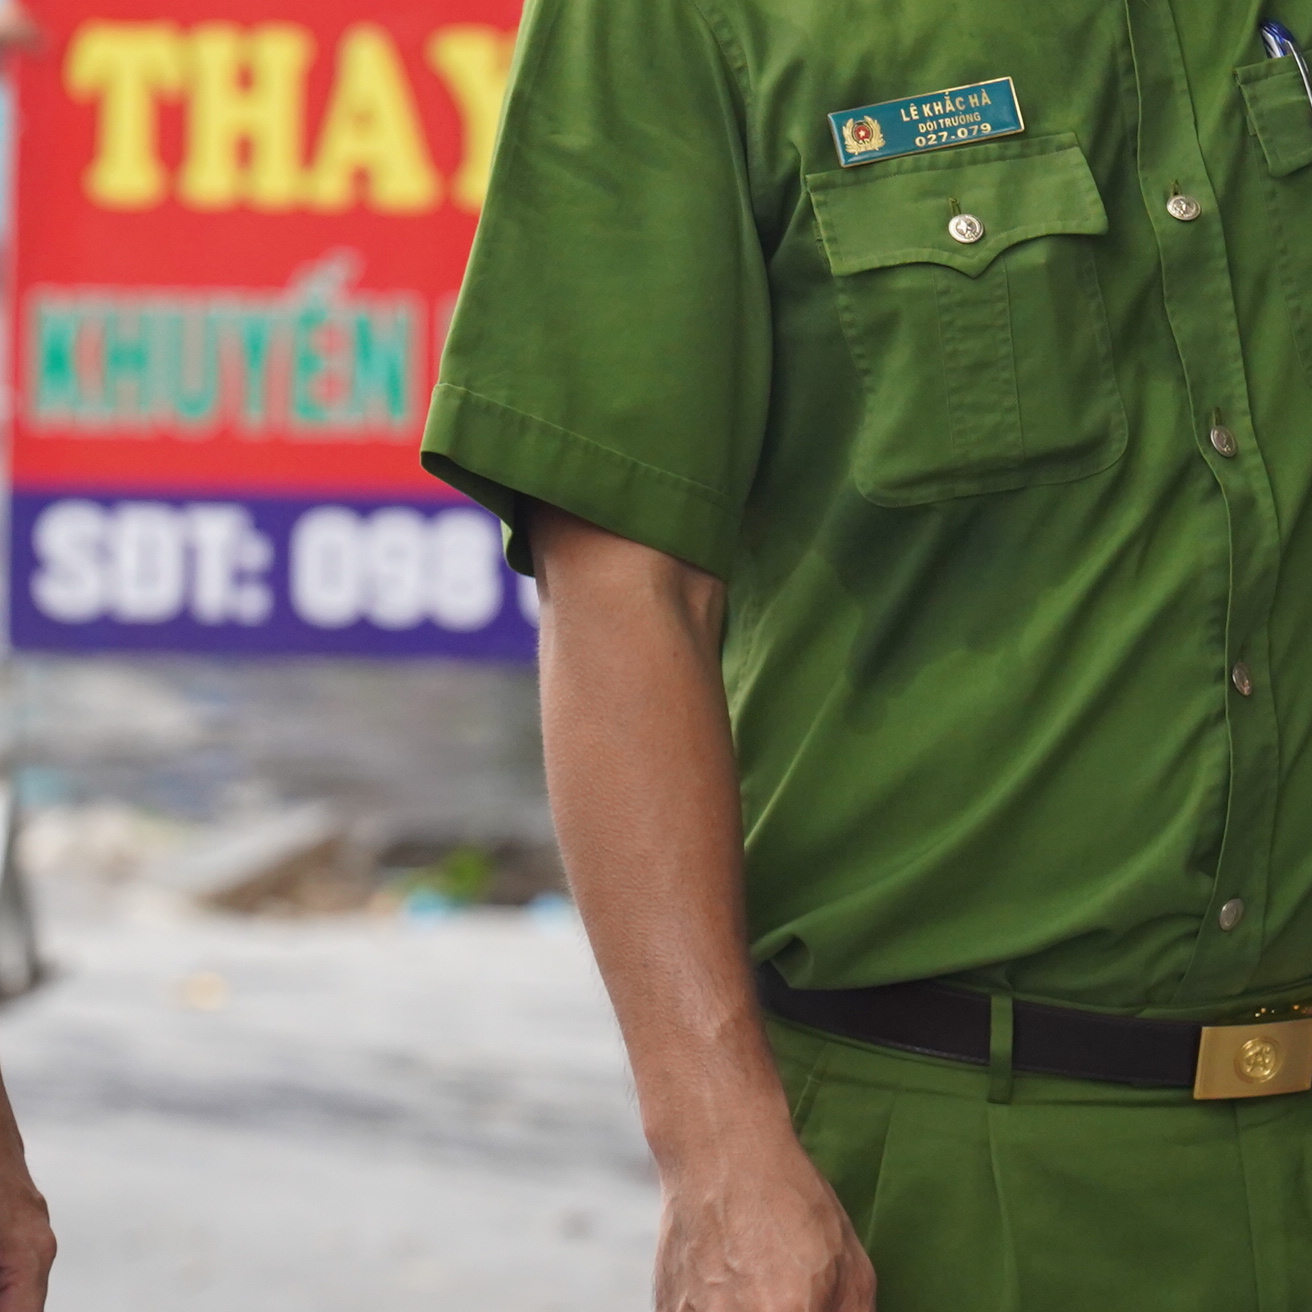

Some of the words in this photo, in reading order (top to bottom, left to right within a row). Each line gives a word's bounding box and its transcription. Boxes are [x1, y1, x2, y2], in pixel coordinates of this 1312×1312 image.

[900, 103, 919, 122] LÊ
[968, 88, 992, 108] HÀ
[30, 250, 418, 432] KHUYẾN
[294, 508, 502, 630] 098
